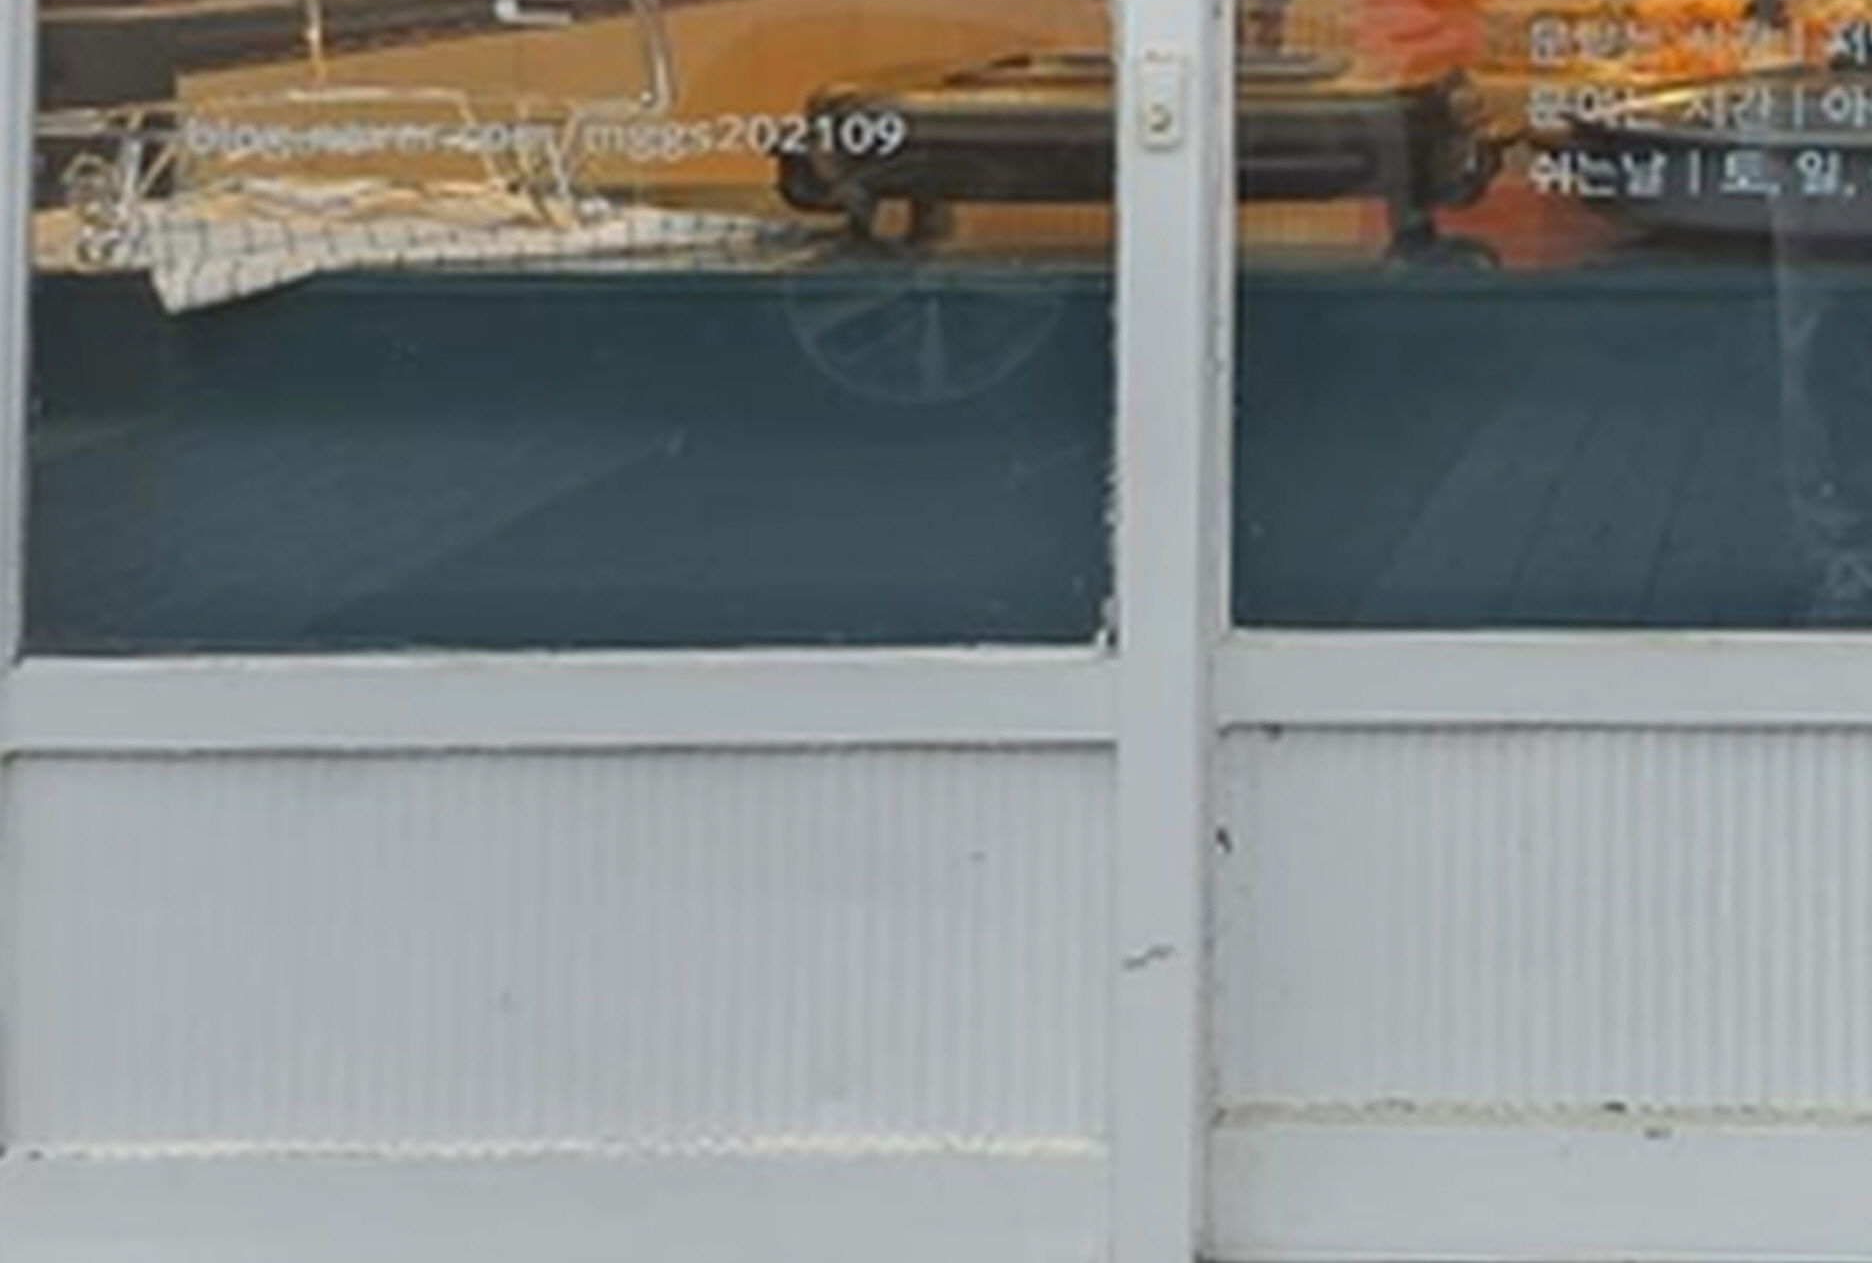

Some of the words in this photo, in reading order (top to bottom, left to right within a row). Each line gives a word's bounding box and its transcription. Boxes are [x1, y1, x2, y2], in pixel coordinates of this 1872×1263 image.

[1684, 85, 1773, 131] 시간
[1528, 149, 1668, 197] 쉬는날
[1719, 150, 1781, 197] 토,
[1797, 150, 1856, 197] 일,
